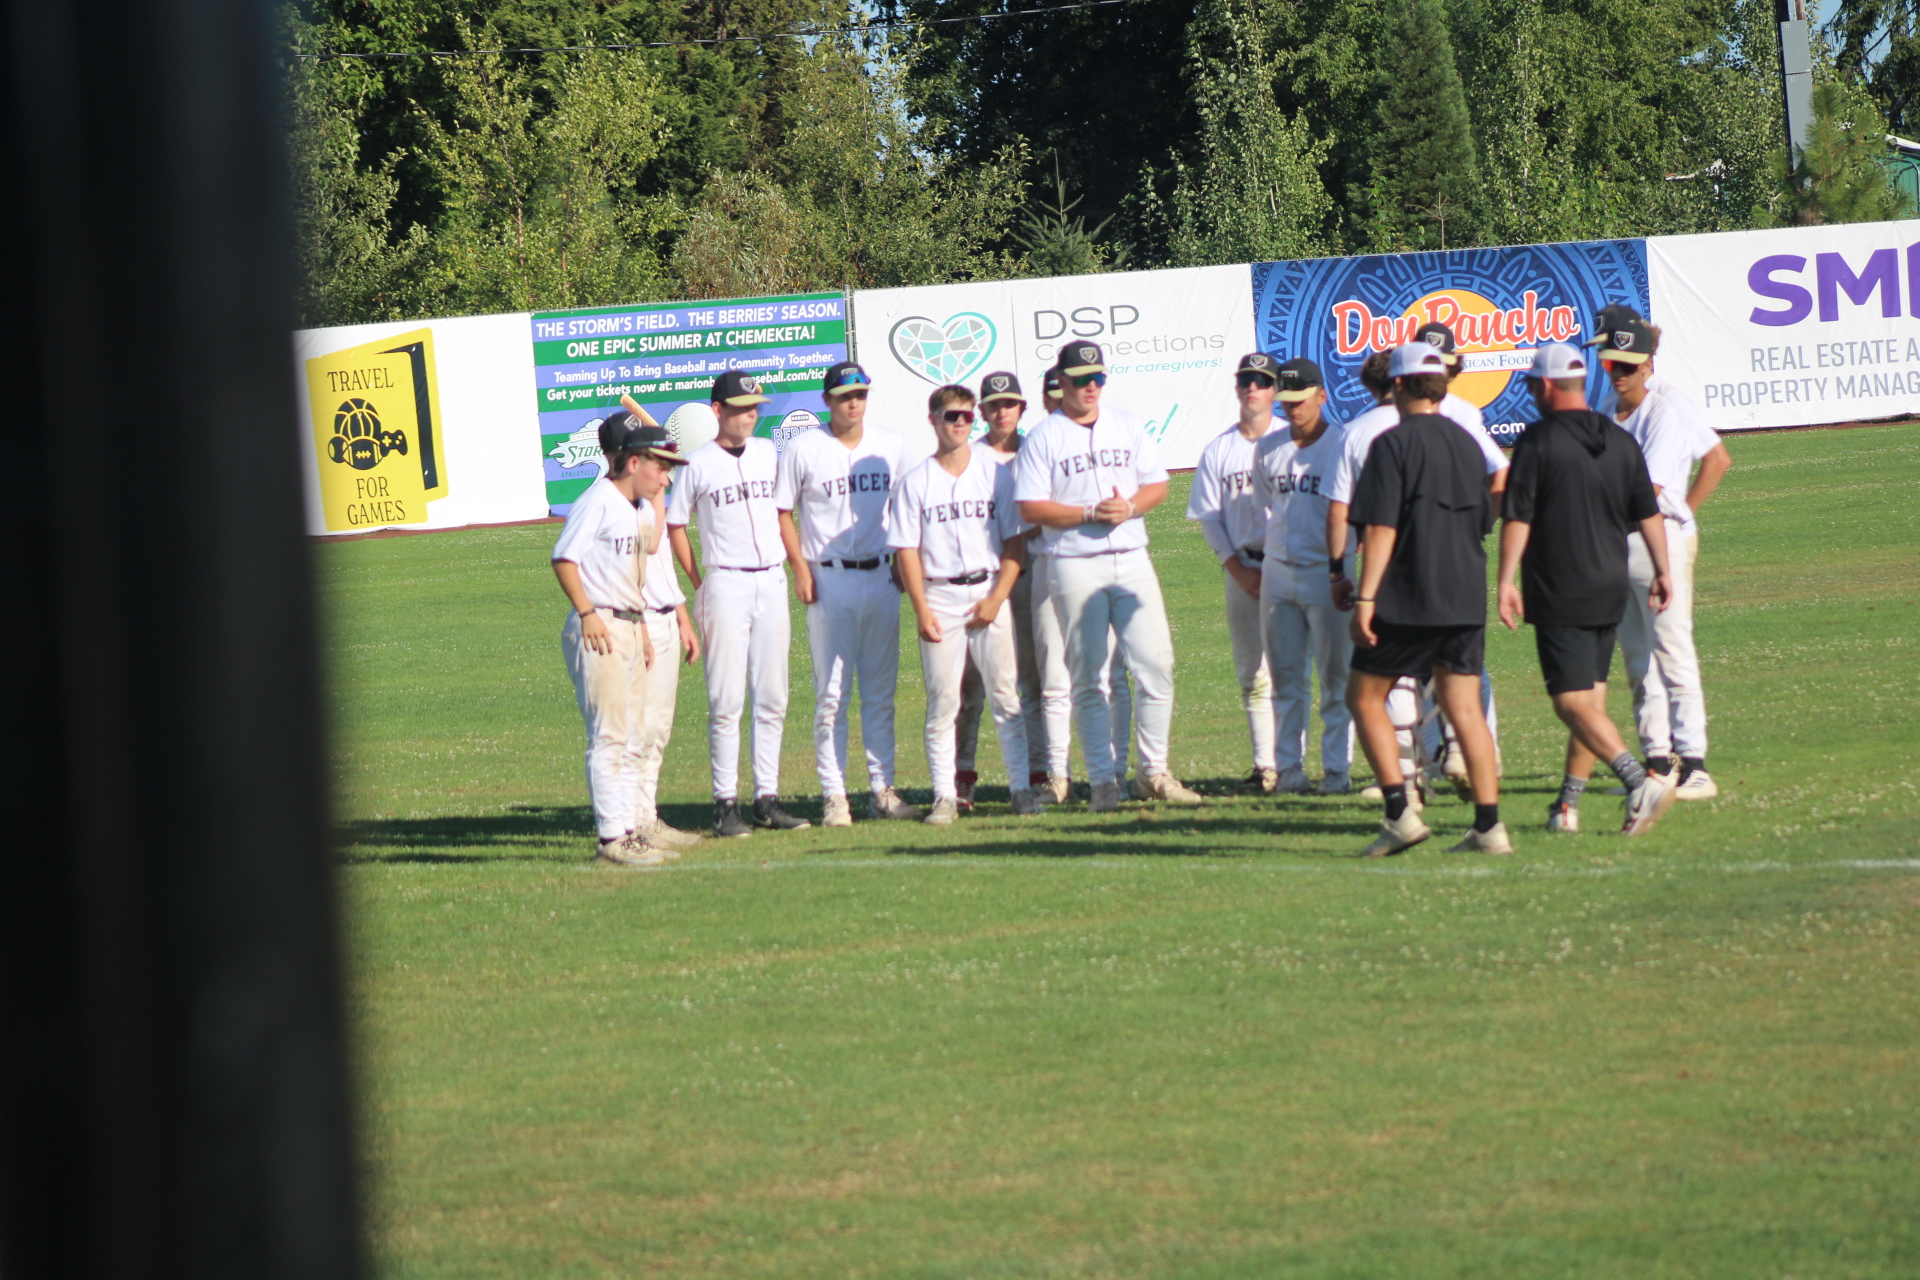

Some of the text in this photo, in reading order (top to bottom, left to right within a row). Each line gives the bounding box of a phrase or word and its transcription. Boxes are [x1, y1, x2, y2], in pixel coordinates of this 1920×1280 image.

[1747, 241, 1920, 326] SM
[536, 302, 841, 337] THE STORM'S FIELD. THE BERRIES' SEASON.
[1034, 305, 1139, 340] DSP
[1332, 300, 1417, 354] Don
[566, 325, 816, 358] ONE EPIC SUMMER AT CHEMEKETA!
[1035, 334, 1225, 361] Cnections
[1750, 337, 1920, 372] REAL ESTATE A
[554, 351, 835, 383] Teaming Up To Bring Baseball and Community Together.
[1109, 364, 1131, 375] for
[1135, 357, 1223, 373] caregivers!
[1462, 354, 1534, 368] XICAN FOOD
[327, 368, 394, 392] TRAVEL
[546, 389, 567, 401] Get
[569, 388, 594, 402] your
[596, 384, 631, 397] tickets
[633, 384, 656, 394] now
[658, 381, 673, 392] at:
[1704, 370, 1920, 408] PROPERTY MANAG
[568, 445, 603, 464] STOR
[356, 476, 390, 499] FOR
[561, 470, 594, 479] ATHLETICS
[347, 500, 406, 525] GAMES
[922, 500, 995, 525] VENCER
